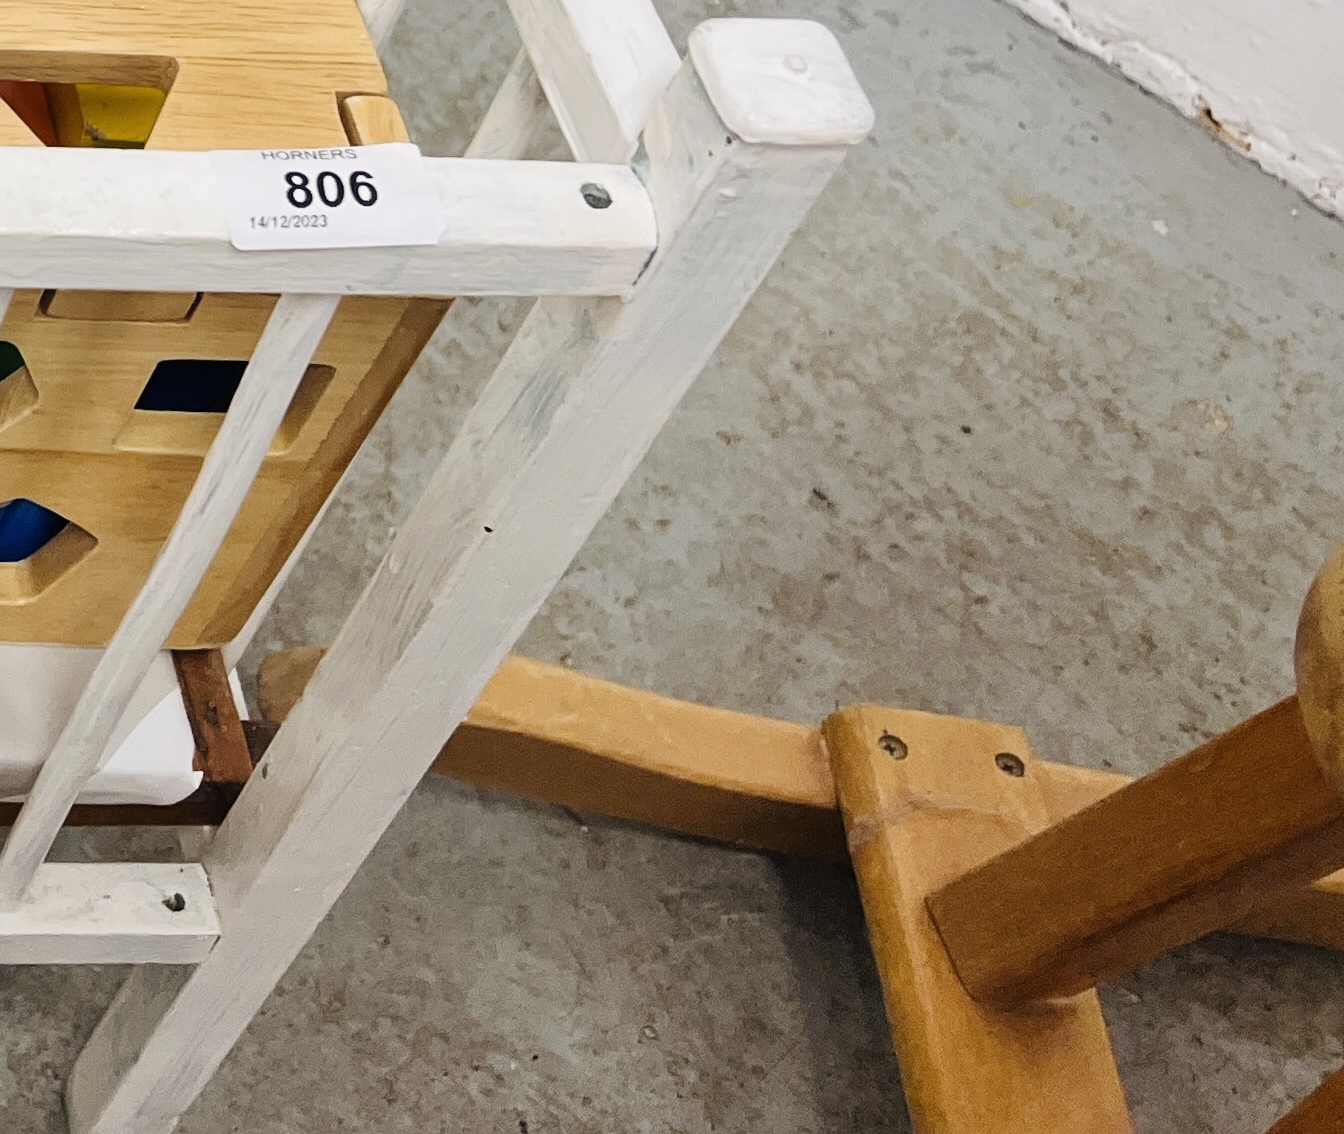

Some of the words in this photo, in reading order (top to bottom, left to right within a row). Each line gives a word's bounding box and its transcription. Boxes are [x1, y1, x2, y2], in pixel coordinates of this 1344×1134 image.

[261, 149, 358, 160] HORNERS
[284, 170, 378, 208] 806
[249, 213, 329, 228] 14/12/2023
